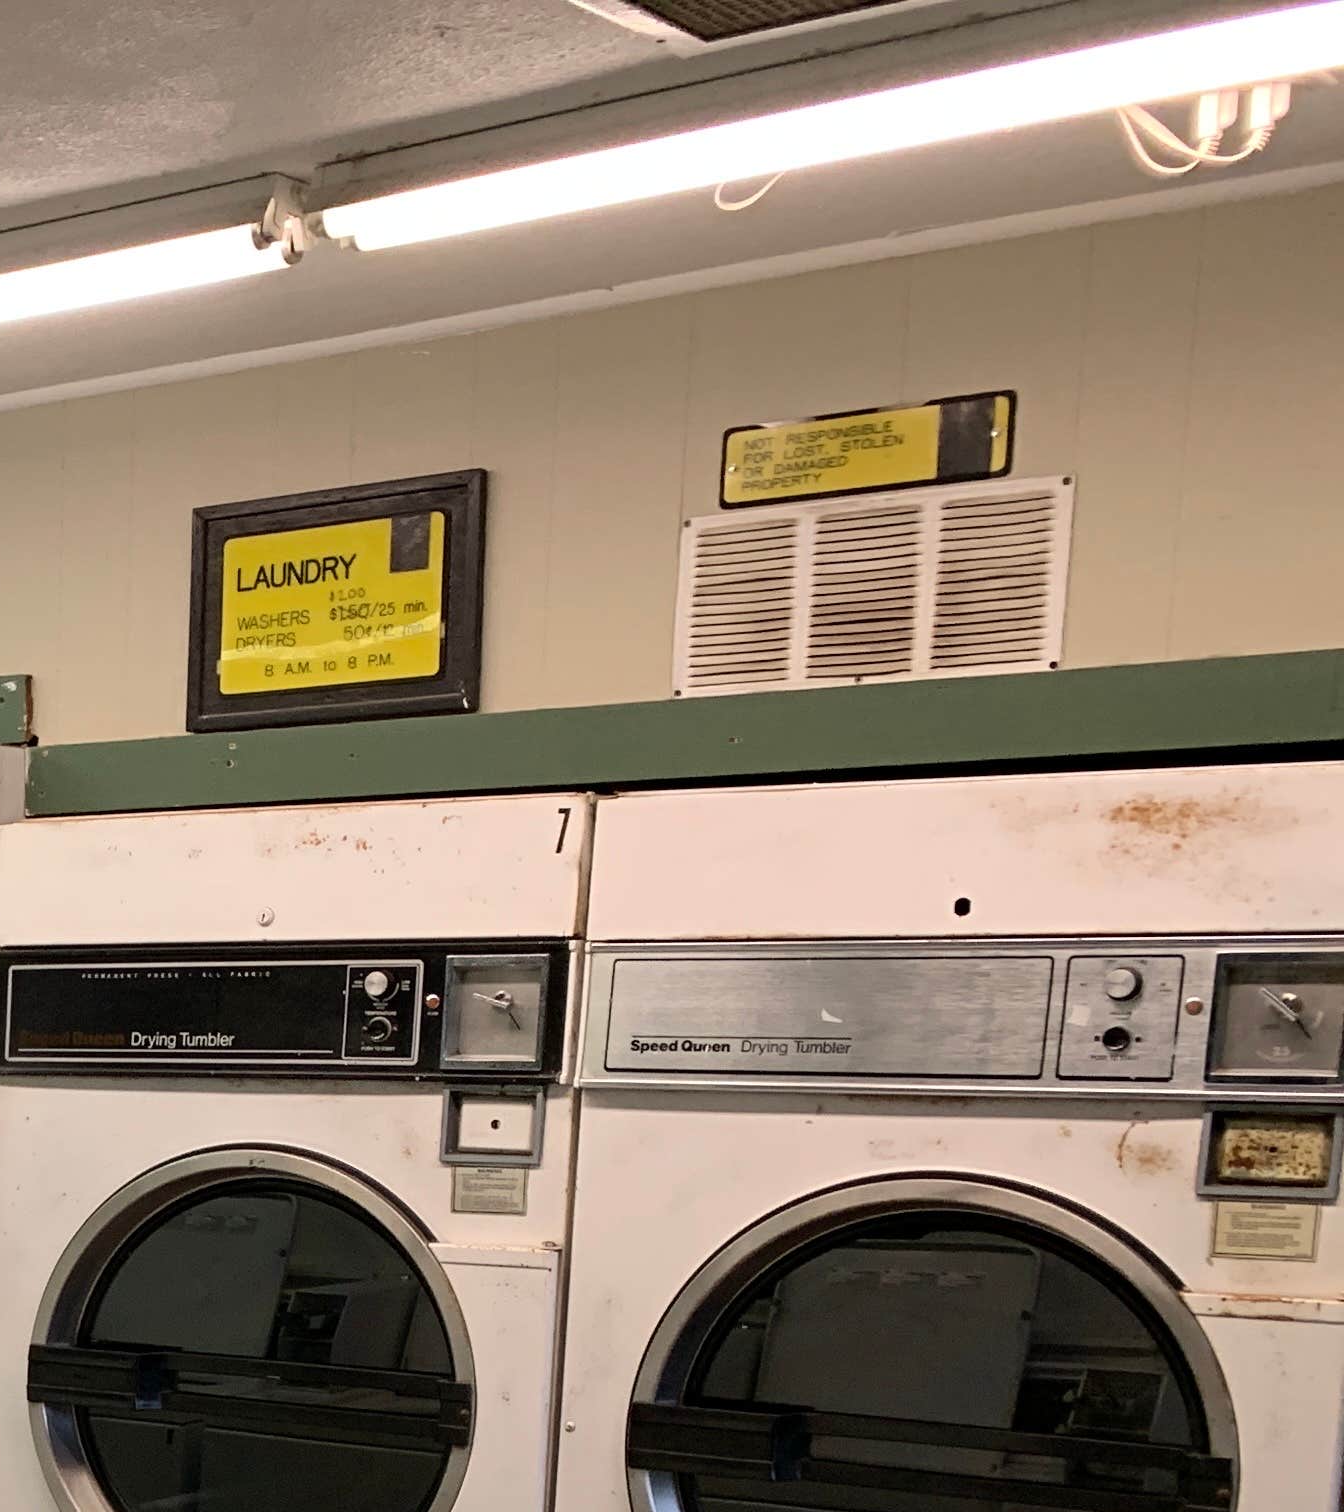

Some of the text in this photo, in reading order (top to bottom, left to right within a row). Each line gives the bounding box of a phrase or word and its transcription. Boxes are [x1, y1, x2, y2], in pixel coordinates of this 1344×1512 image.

[744, 420, 894, 450] NOT RESPONSIBLE
[743, 451, 774, 465] FOR
[840, 434, 905, 453] STOLEN
[743, 456, 849, 479] OR DAMAGED
[741, 473, 822, 492] PROPERTY
[237, 553, 357, 592] LAUNDRY
[236, 609, 311, 631] WASHERS
[235, 632, 297, 652] DRYERS
[264, 663, 274, 677] 8
[284, 662, 312, 675] A.M.
[323, 659, 337, 672] to
[347, 656, 358, 669] 8
[555, 807, 572, 854] 7
[130, 1031, 236, 1049] Drying Tumbler
[630, 1039, 679, 1055] Speed
[740, 1040, 789, 1057] Drying
[794, 1040, 853, 1055] Tumbler
